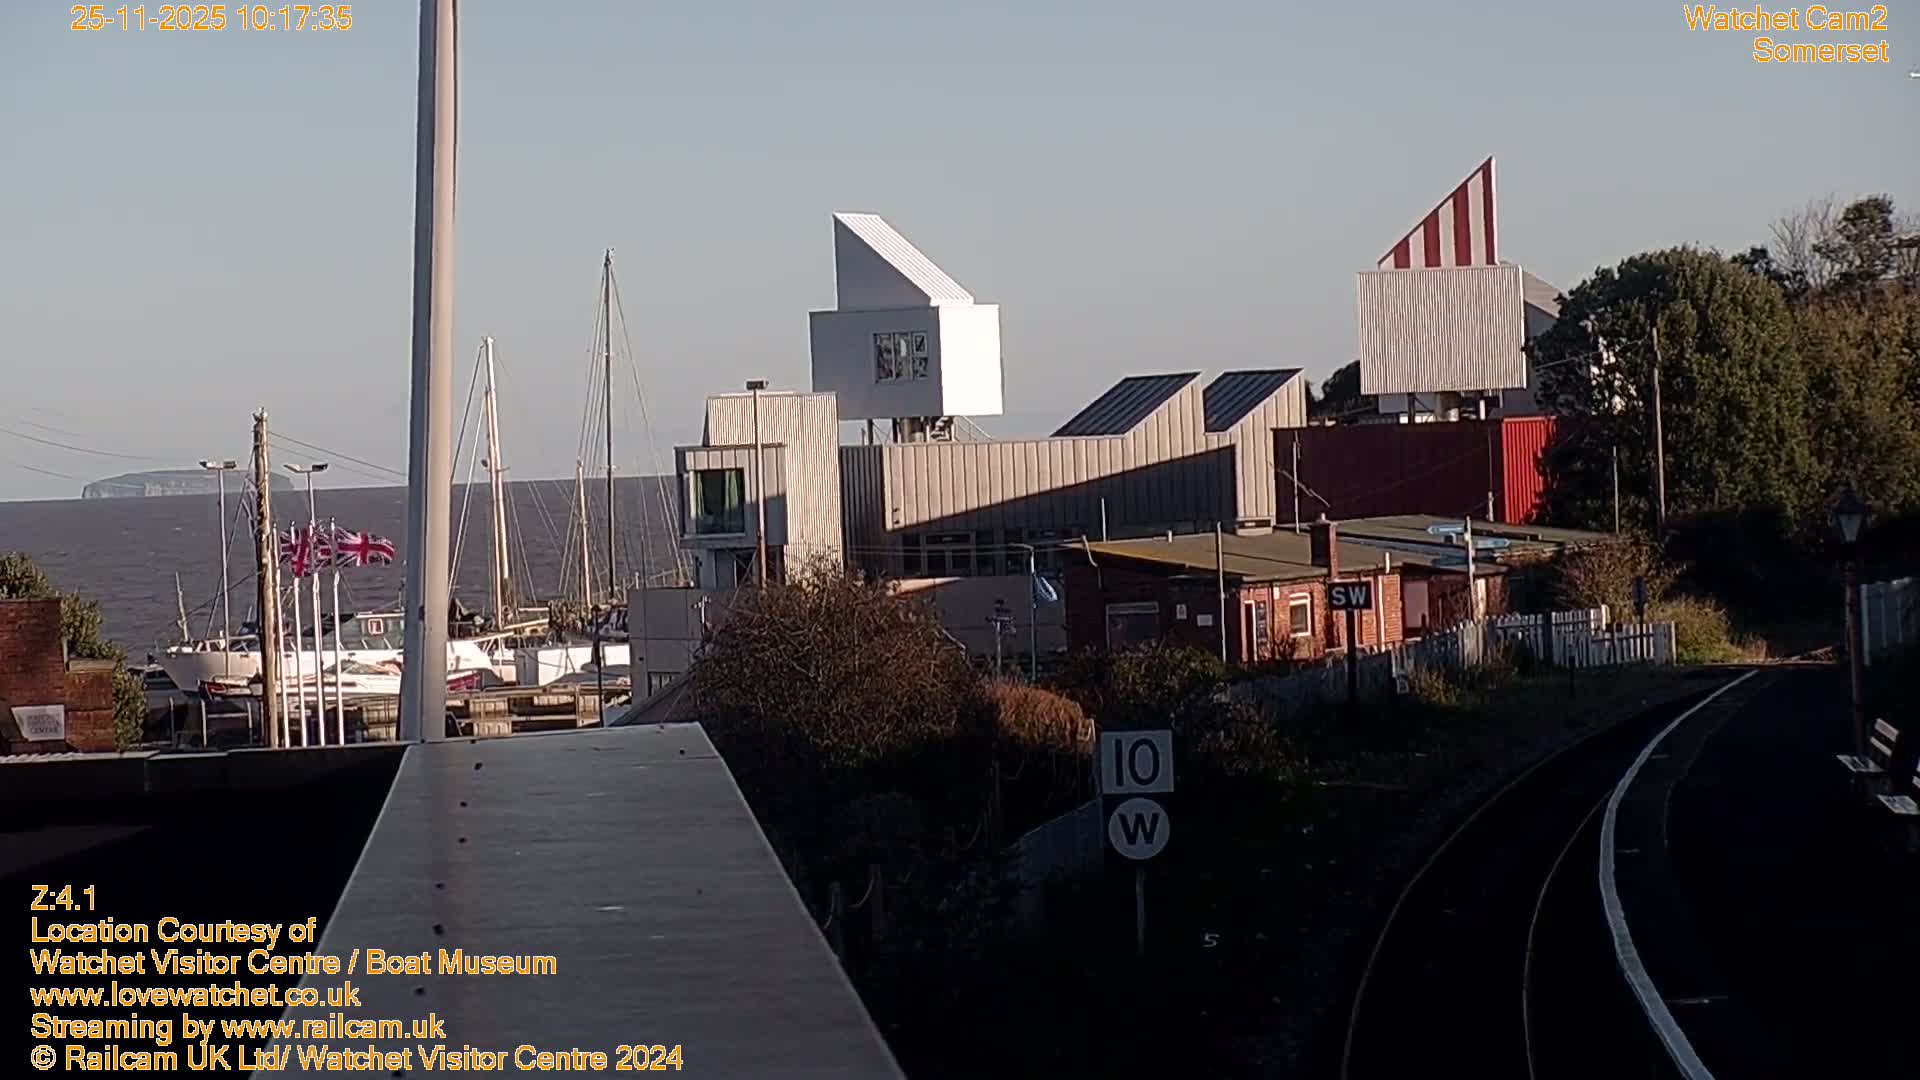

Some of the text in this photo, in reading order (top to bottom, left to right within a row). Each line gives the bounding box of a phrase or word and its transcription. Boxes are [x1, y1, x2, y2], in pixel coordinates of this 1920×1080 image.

[1332, 586, 1366, 606] SW
[1115, 738, 1160, 787] 10
[1118, 812, 1160, 845] W
